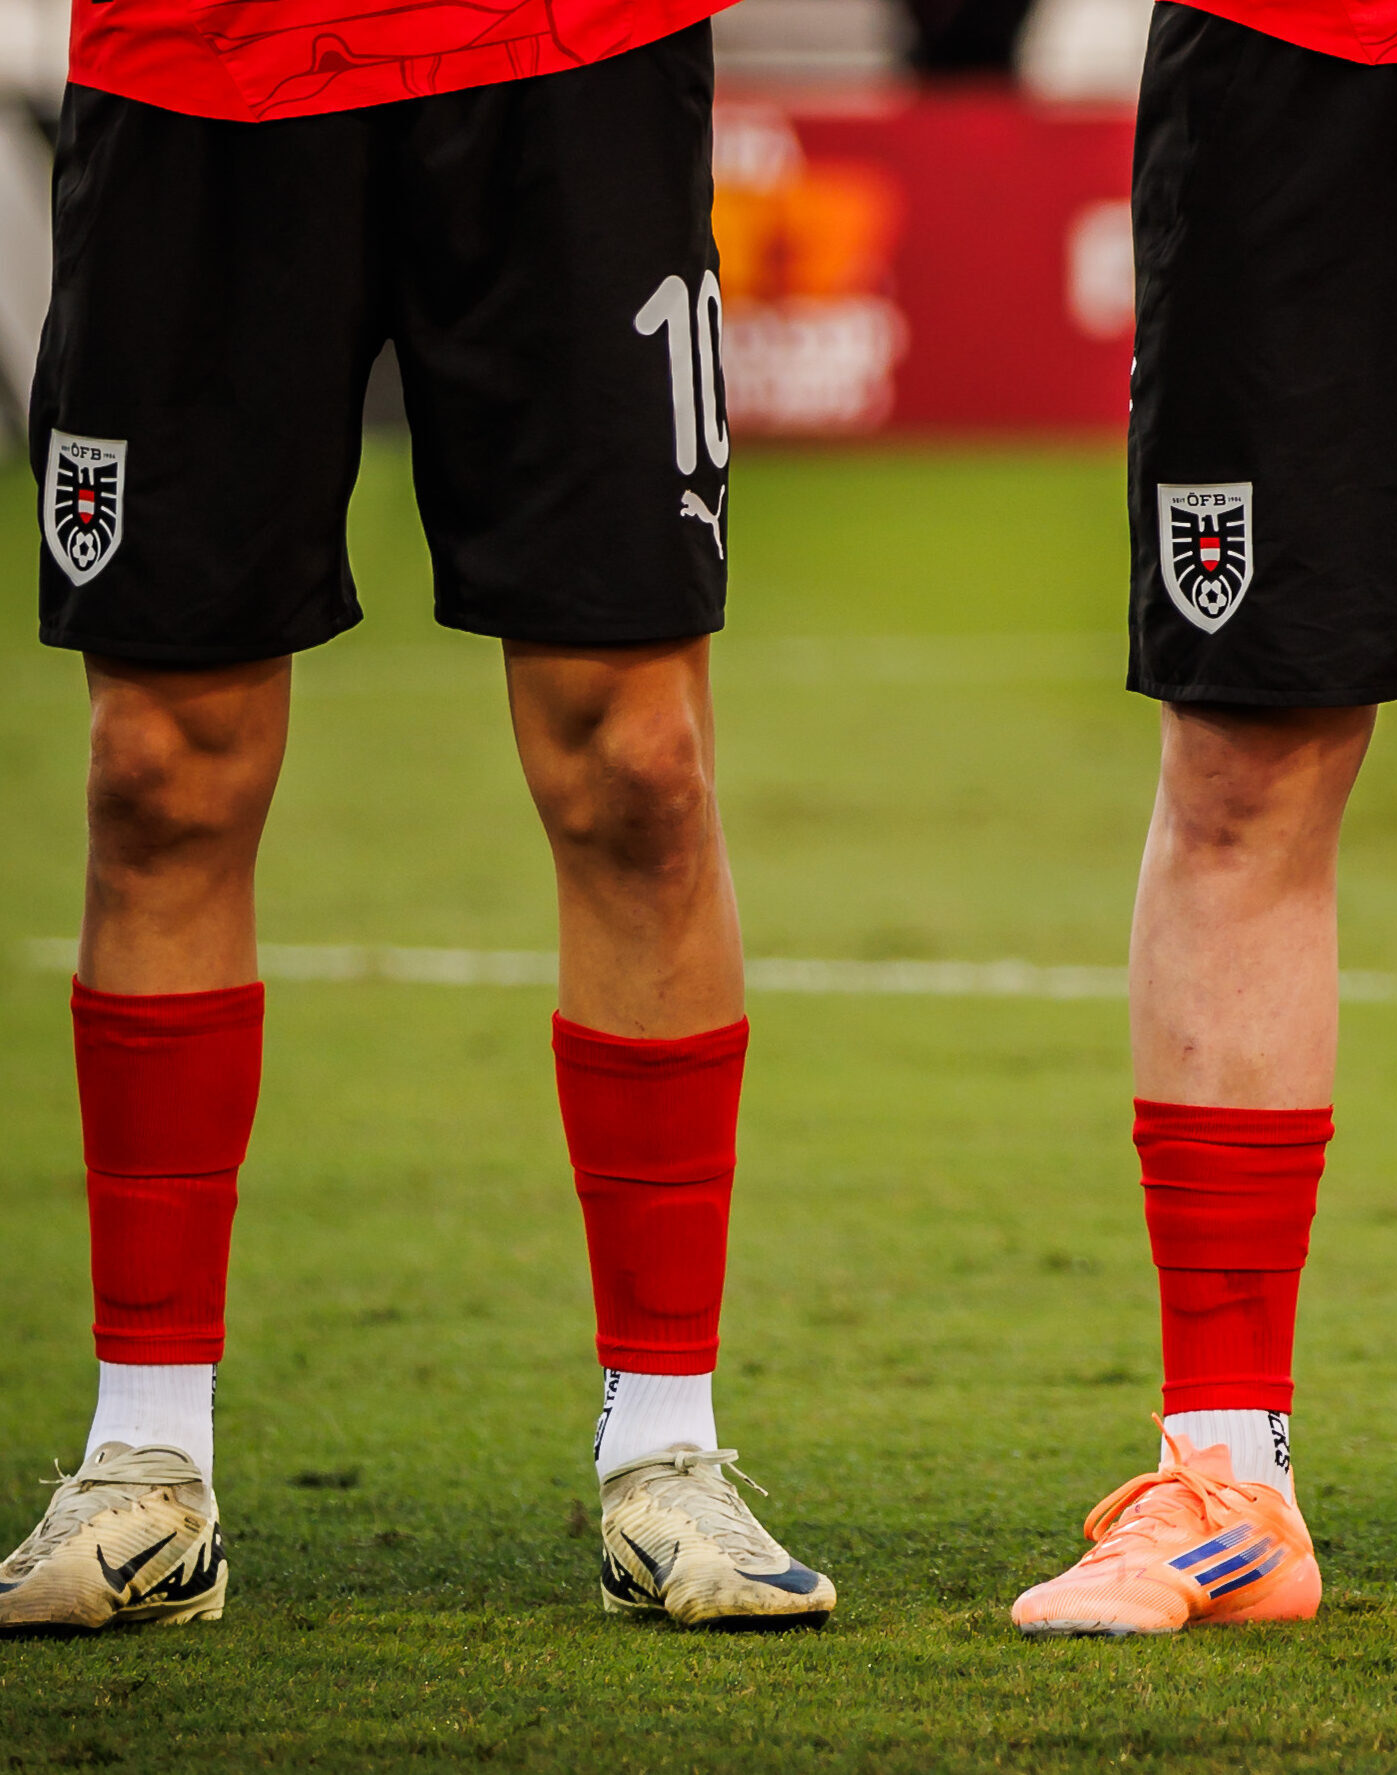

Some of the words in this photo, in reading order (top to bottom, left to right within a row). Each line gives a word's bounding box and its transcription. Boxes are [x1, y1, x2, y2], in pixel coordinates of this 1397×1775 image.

[634, 269, 730, 476] 10
[71, 442, 101, 460] ÖFB
[1187, 492, 1226, 507] ÖFB
